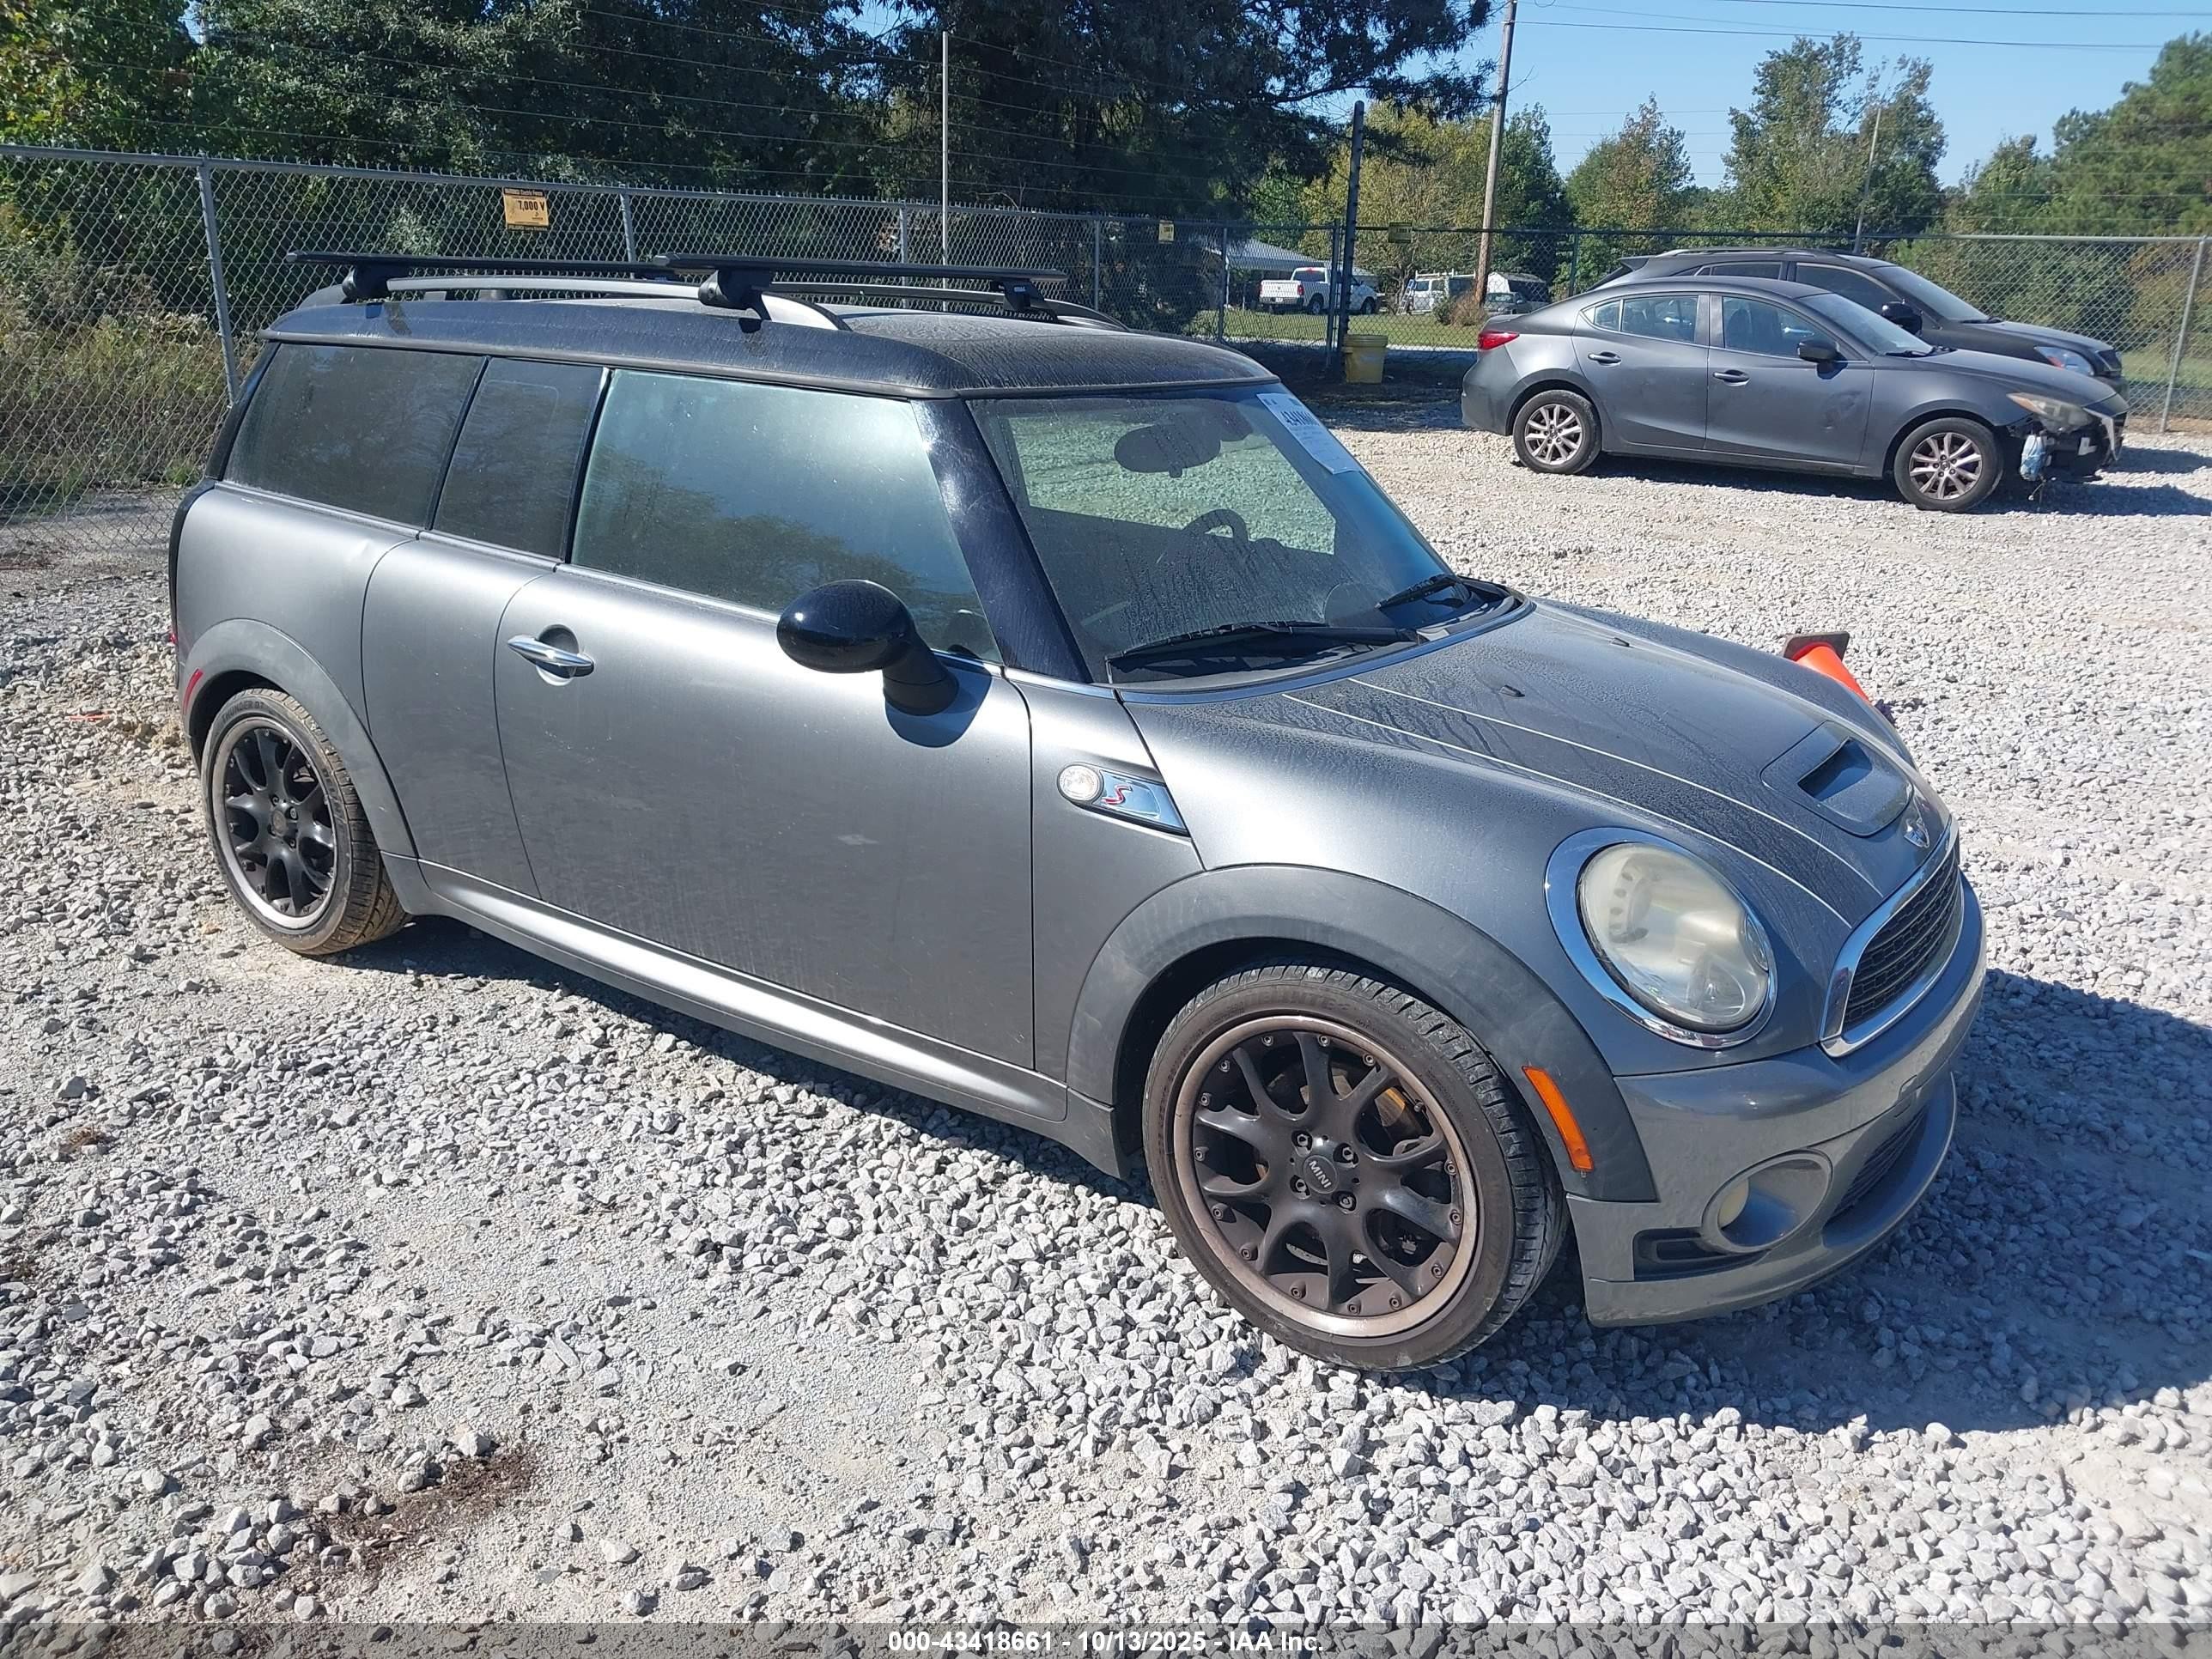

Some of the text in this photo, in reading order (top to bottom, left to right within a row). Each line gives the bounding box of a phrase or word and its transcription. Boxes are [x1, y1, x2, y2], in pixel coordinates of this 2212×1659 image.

[519, 201, 545, 211] 7,000 V
[1102, 784, 1132, 805] S
[1309, 1160, 1332, 1188] MINI
